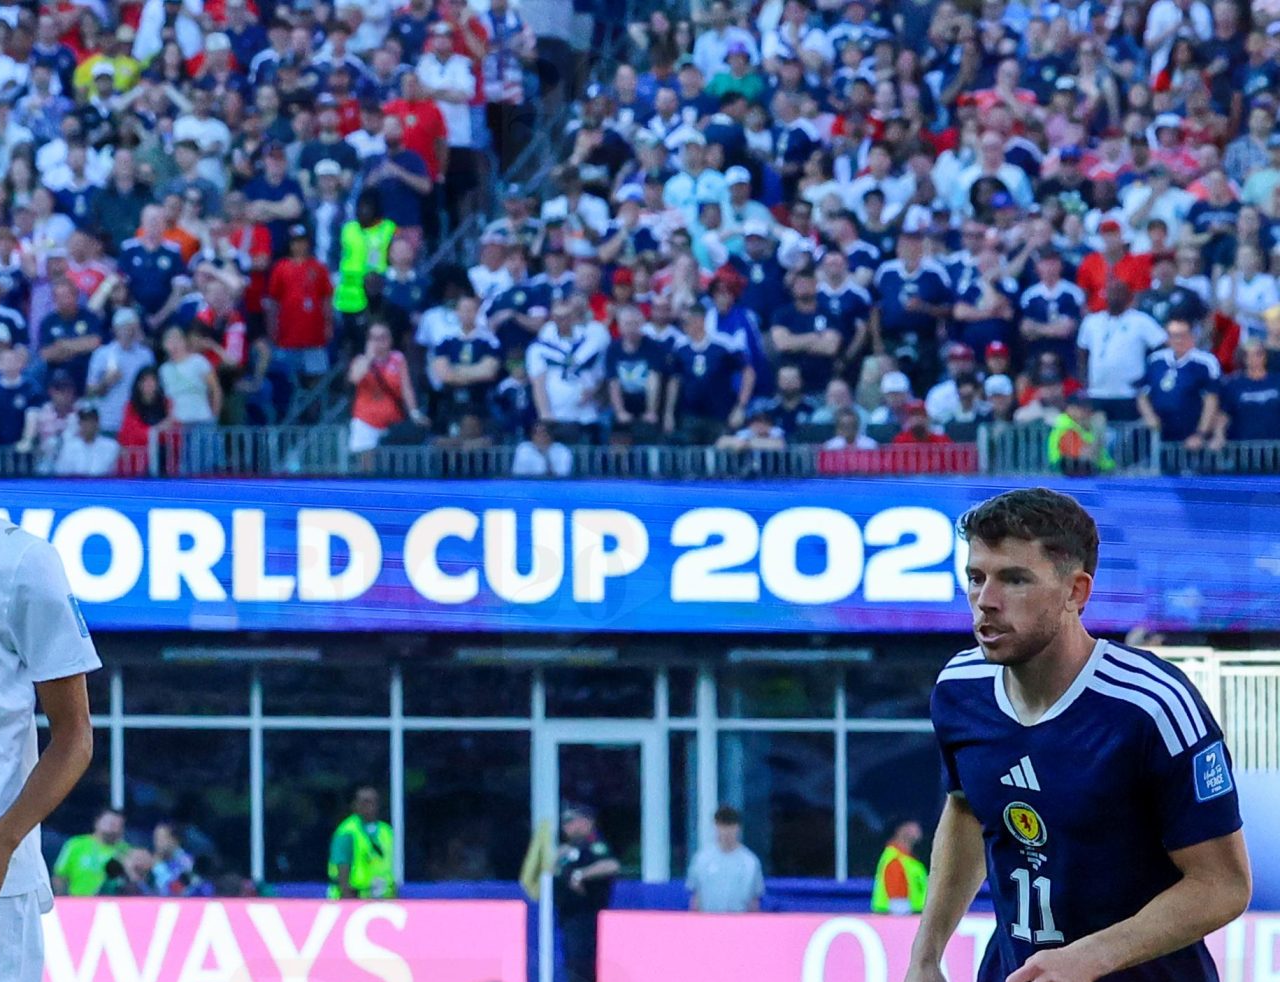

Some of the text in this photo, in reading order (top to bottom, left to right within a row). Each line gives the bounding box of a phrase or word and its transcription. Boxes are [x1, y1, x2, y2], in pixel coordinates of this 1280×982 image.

[404, 506, 650, 603] CUP
[670, 505, 968, 603] 202
[1009, 868, 1065, 944] 11
